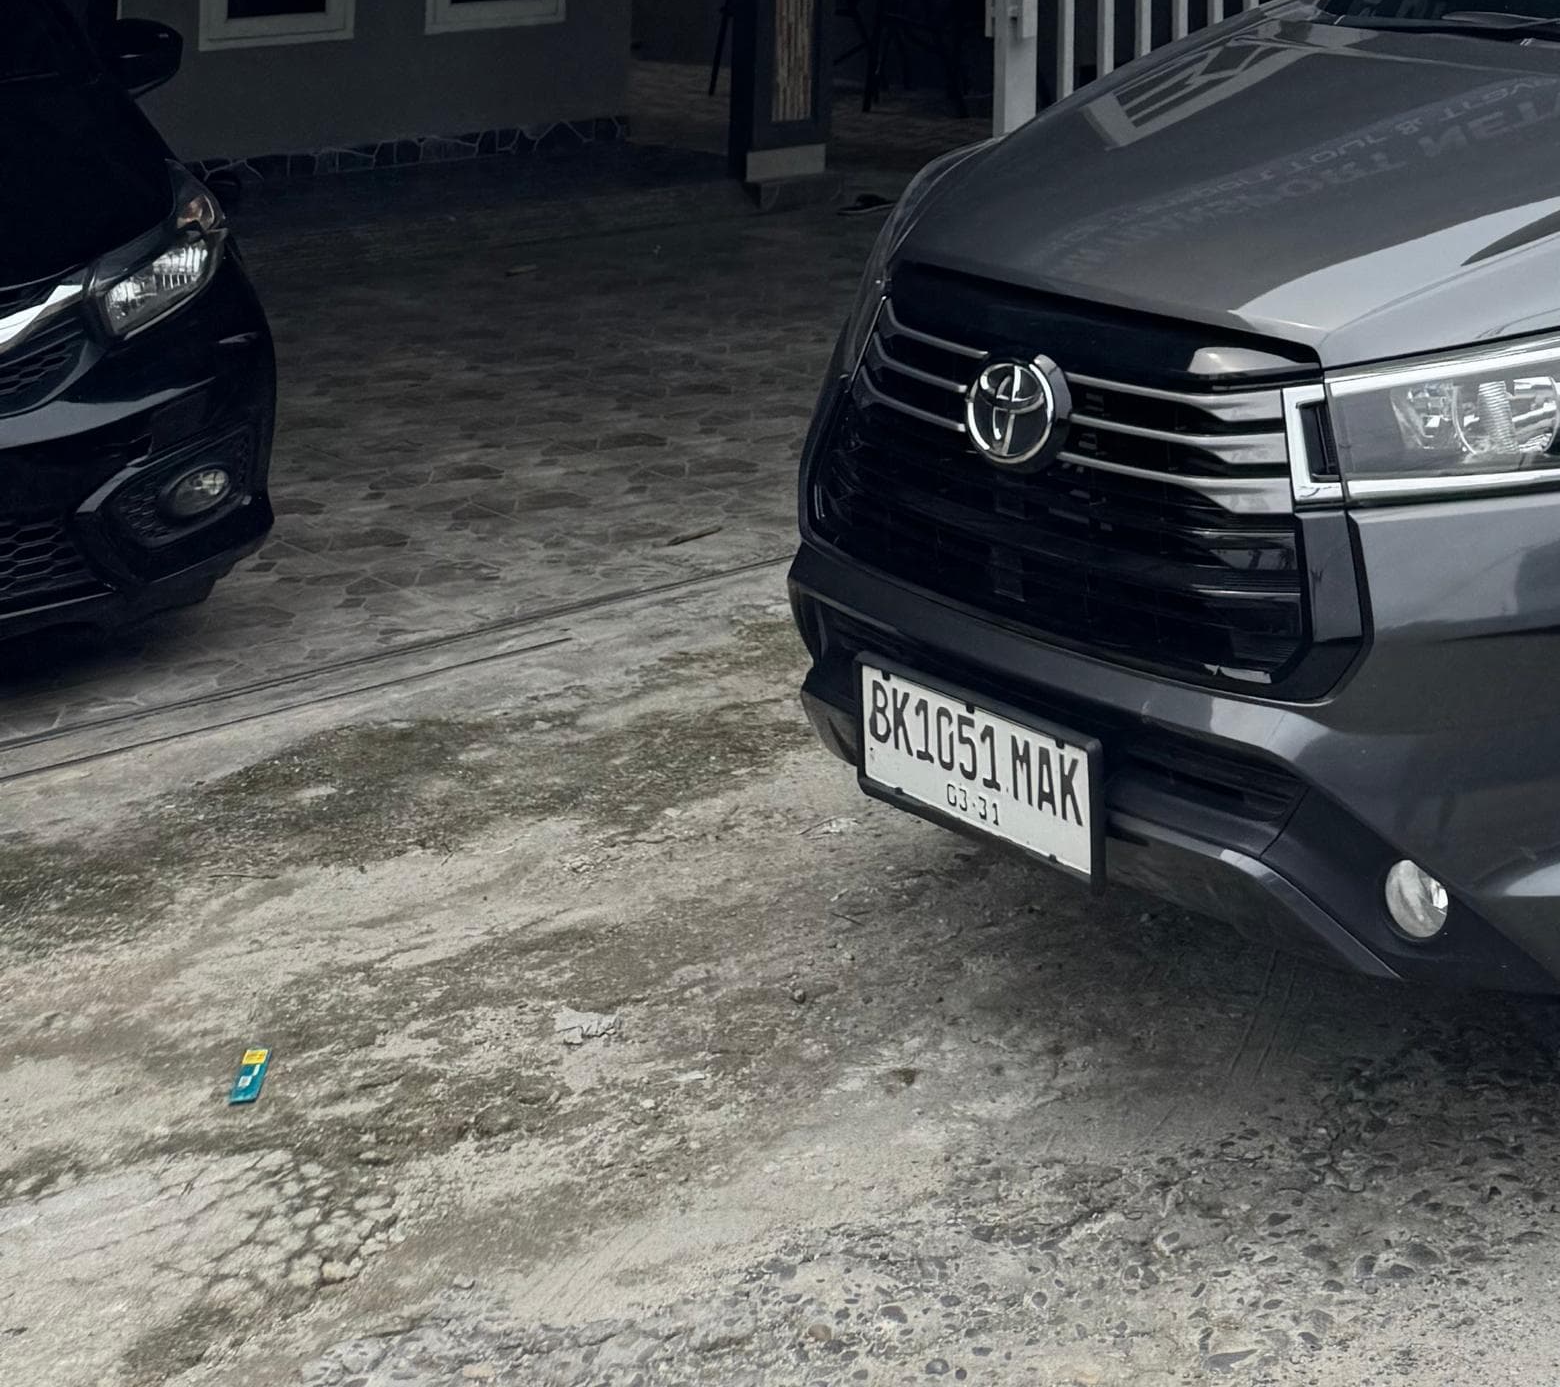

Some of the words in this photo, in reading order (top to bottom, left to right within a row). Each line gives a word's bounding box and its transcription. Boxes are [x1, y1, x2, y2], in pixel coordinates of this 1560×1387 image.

[868, 679, 914, 757] BK
[914, 698, 1001, 792] 1051
[1010, 733, 1083, 827] MAK
